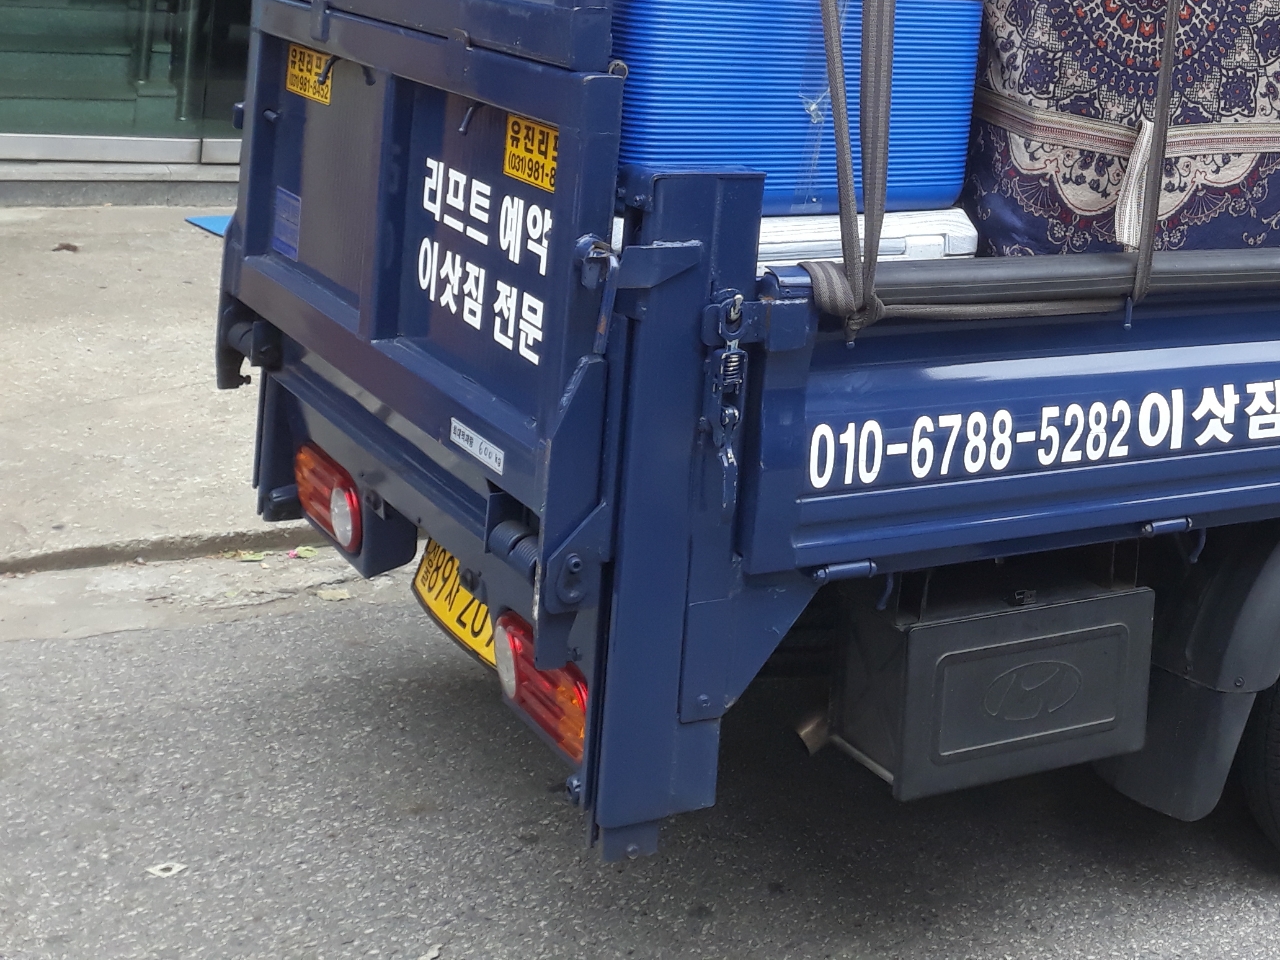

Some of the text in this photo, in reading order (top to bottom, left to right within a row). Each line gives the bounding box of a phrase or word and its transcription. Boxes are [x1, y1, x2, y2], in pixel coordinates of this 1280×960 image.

[423, 157, 553, 276] 리프트 예약
[418, 237, 544, 366] 이삿짐 전문
[809, 399, 1132, 489] 010-6788-5282
